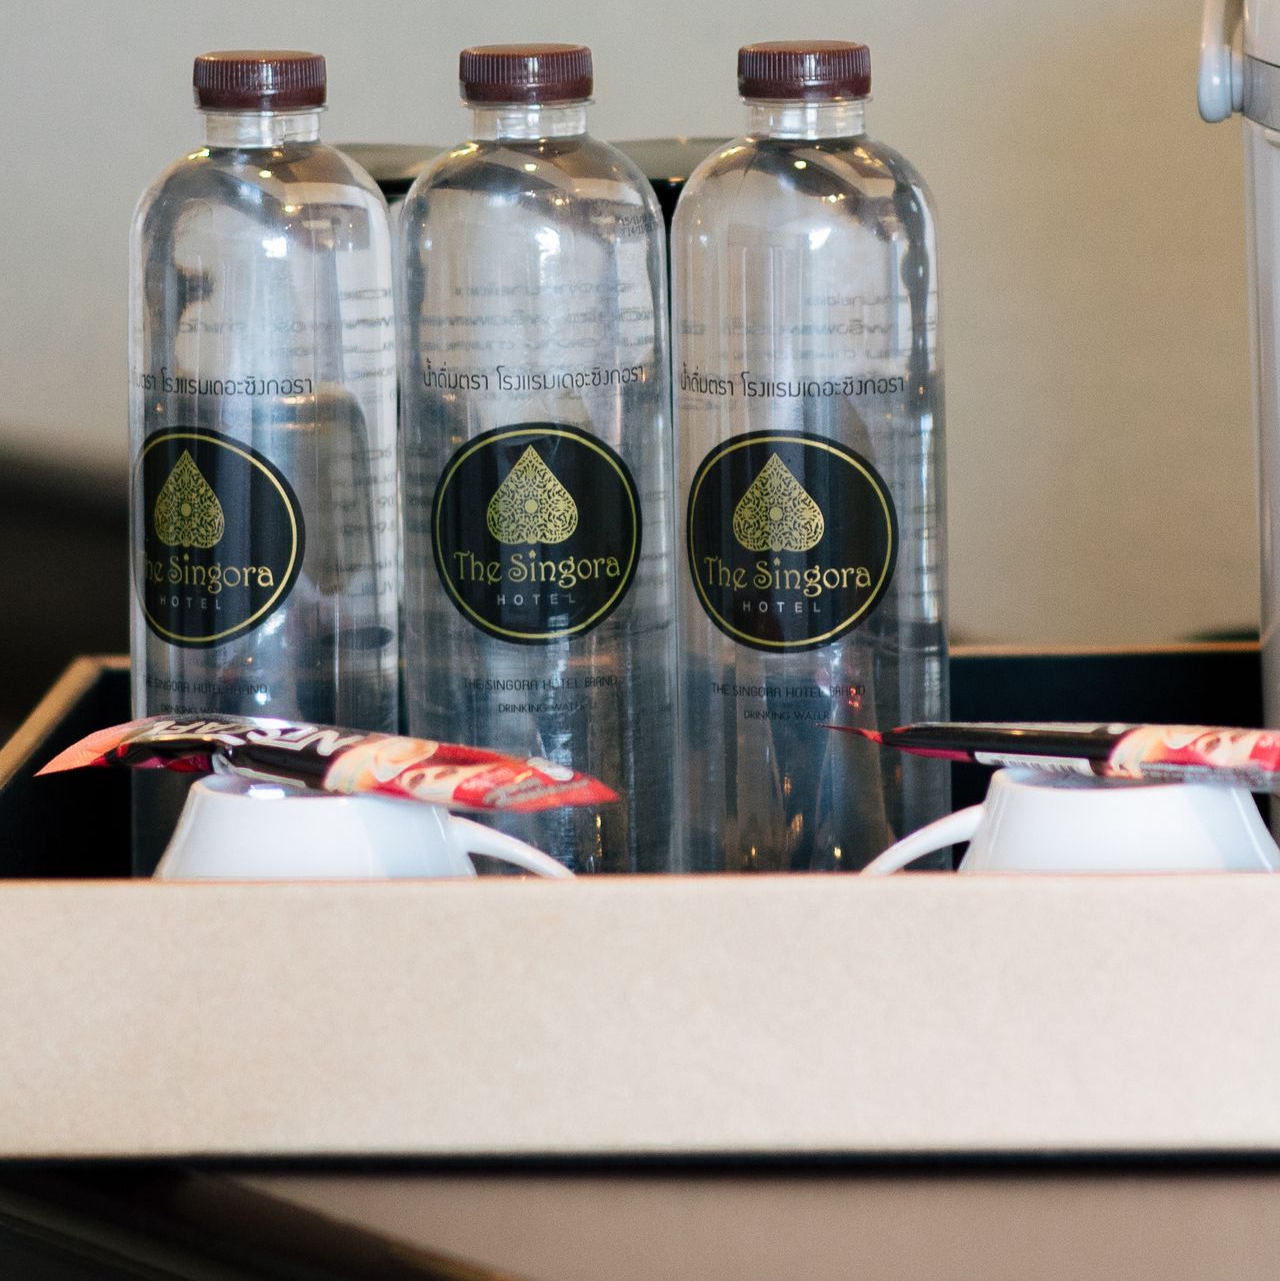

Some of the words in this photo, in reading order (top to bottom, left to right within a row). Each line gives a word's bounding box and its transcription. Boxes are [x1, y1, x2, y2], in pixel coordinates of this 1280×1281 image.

[167, 553, 274, 594] Singora
[454, 550, 502, 585] The
[508, 550, 620, 589] Singora
[704, 556, 748, 591] The
[753, 557, 871, 598] Singora
[160, 596, 222, 609] HOTEL
[497, 594, 576, 606] HOTEL
[743, 601, 821, 613] HOTEL
[486, 679, 539, 691] SINGORA
[733, 686, 781, 698] SINGORA
